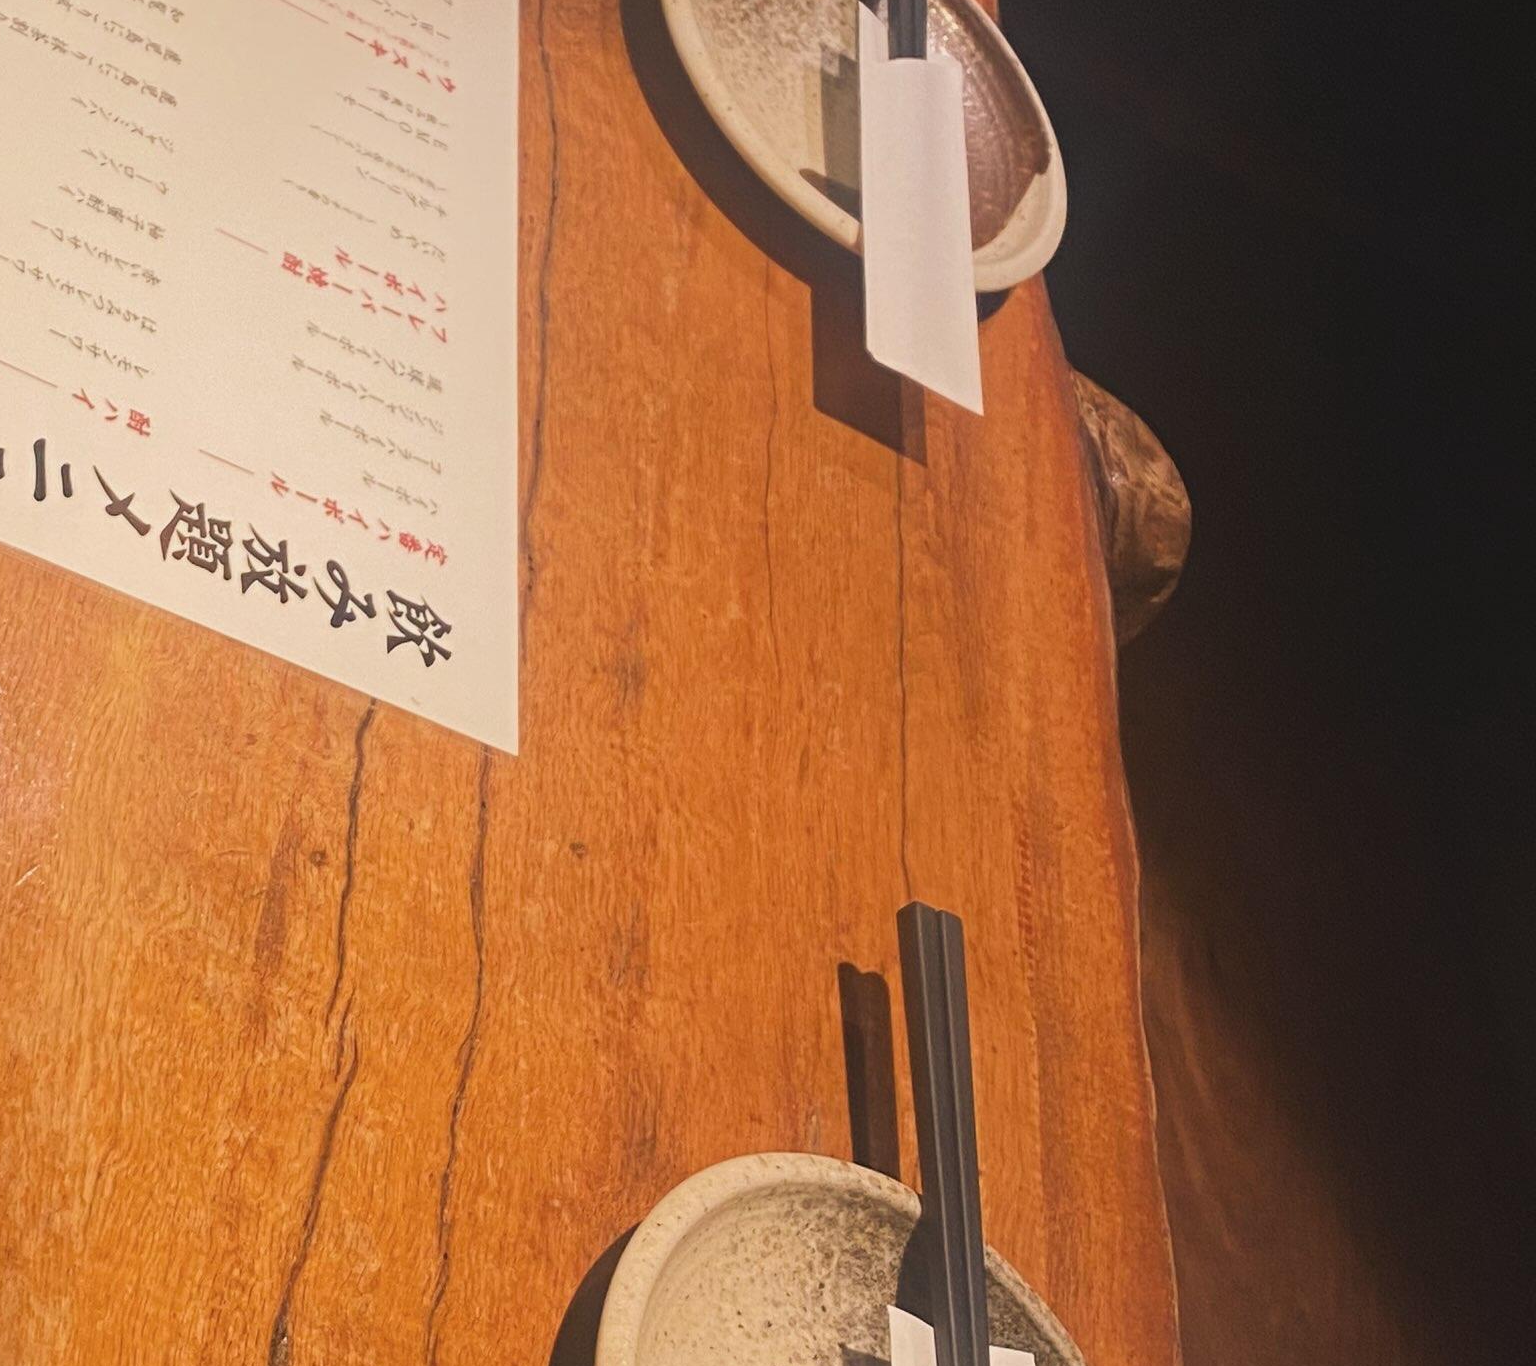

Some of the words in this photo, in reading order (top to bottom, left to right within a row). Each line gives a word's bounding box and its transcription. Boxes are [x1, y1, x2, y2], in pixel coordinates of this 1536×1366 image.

[345, 32, 456, 93] ウィスキー
[281, 251, 447, 343] フレーバー焼酎
[335, 247, 447, 313] ハイボール
[49, 329, 149, 379] レモンサワー
[72, 388, 151, 438] 酎ハイ
[320, 410, 441, 475] コーラハイボール
[270, 472, 448, 567] 定番ハイボール
[362, 471, 437, 515] ハイボール
